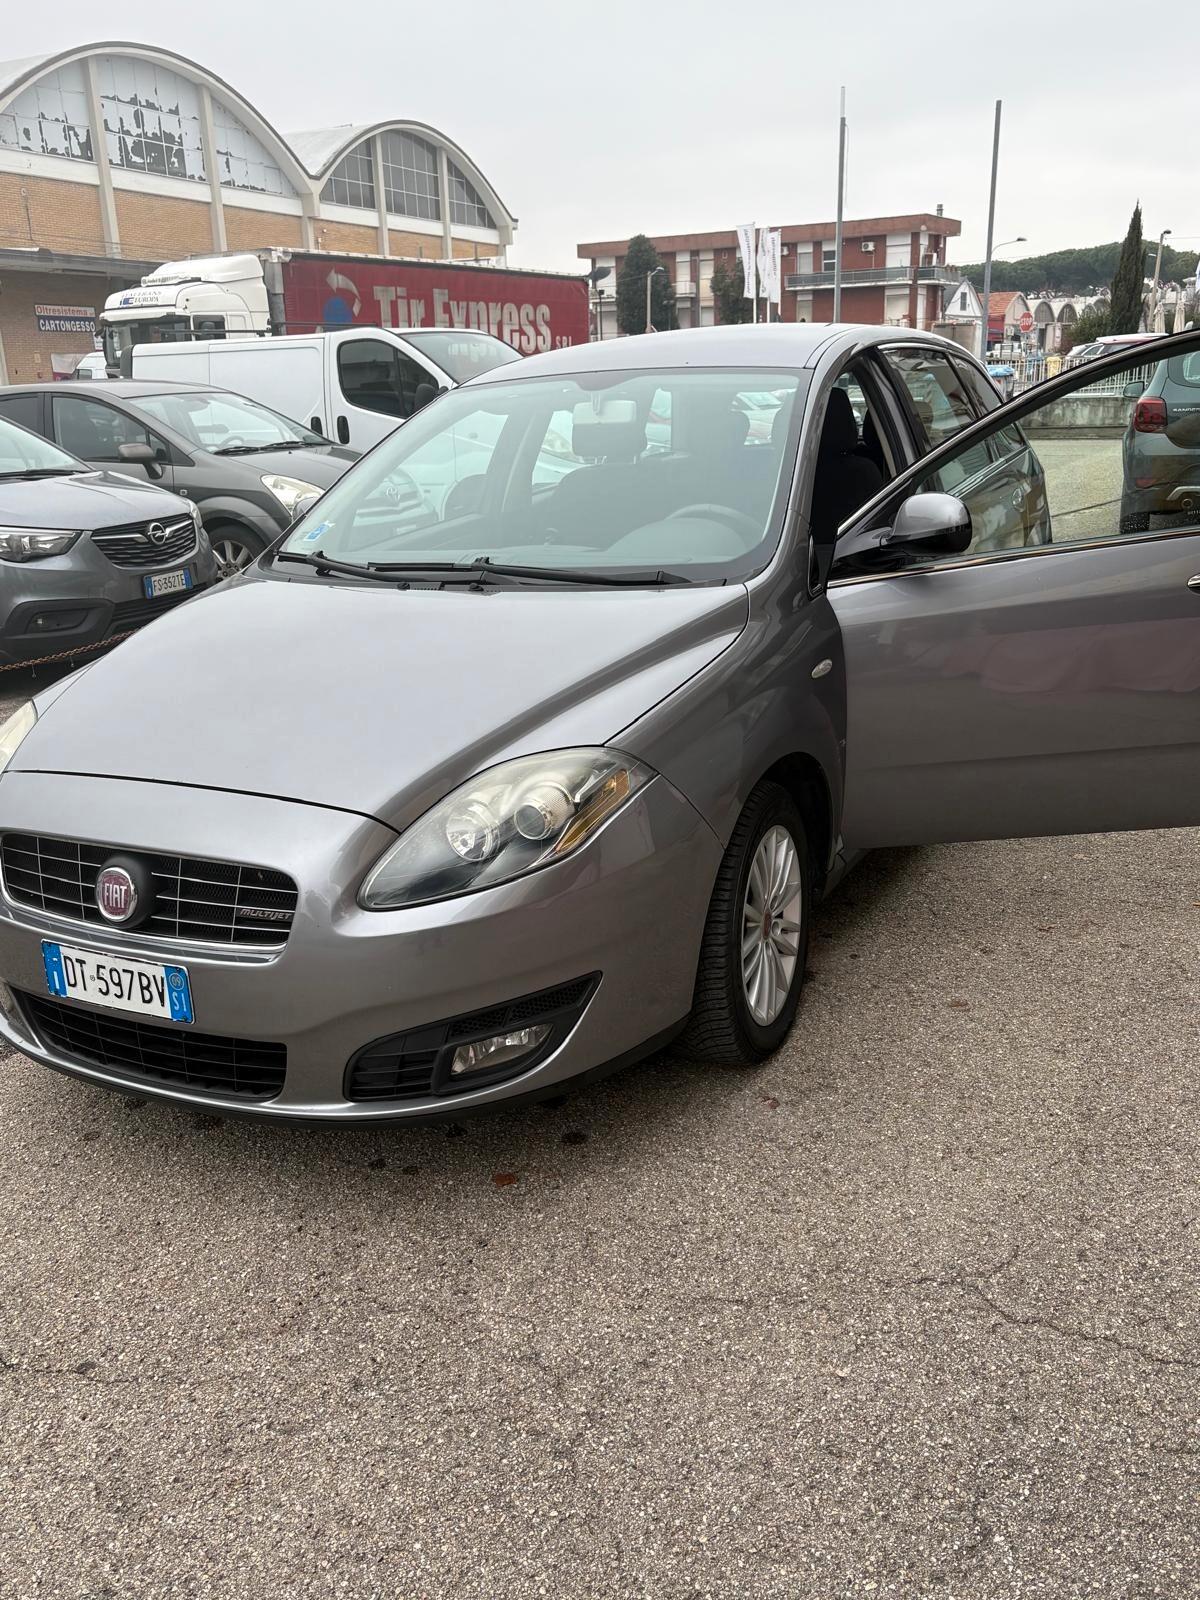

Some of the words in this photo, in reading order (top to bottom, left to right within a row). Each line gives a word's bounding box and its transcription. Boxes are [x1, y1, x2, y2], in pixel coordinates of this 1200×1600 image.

[36, 306, 88, 316] Oltresistema
[39, 319, 96, 332] CARTONGESSO
[373, 286, 425, 328] Tir
[433, 288, 551, 353] Express
[1020, 317, 1034, 326] STOP
[104, 883, 128, 909] FIAT
[239, 908, 293, 920] MULTIJET
